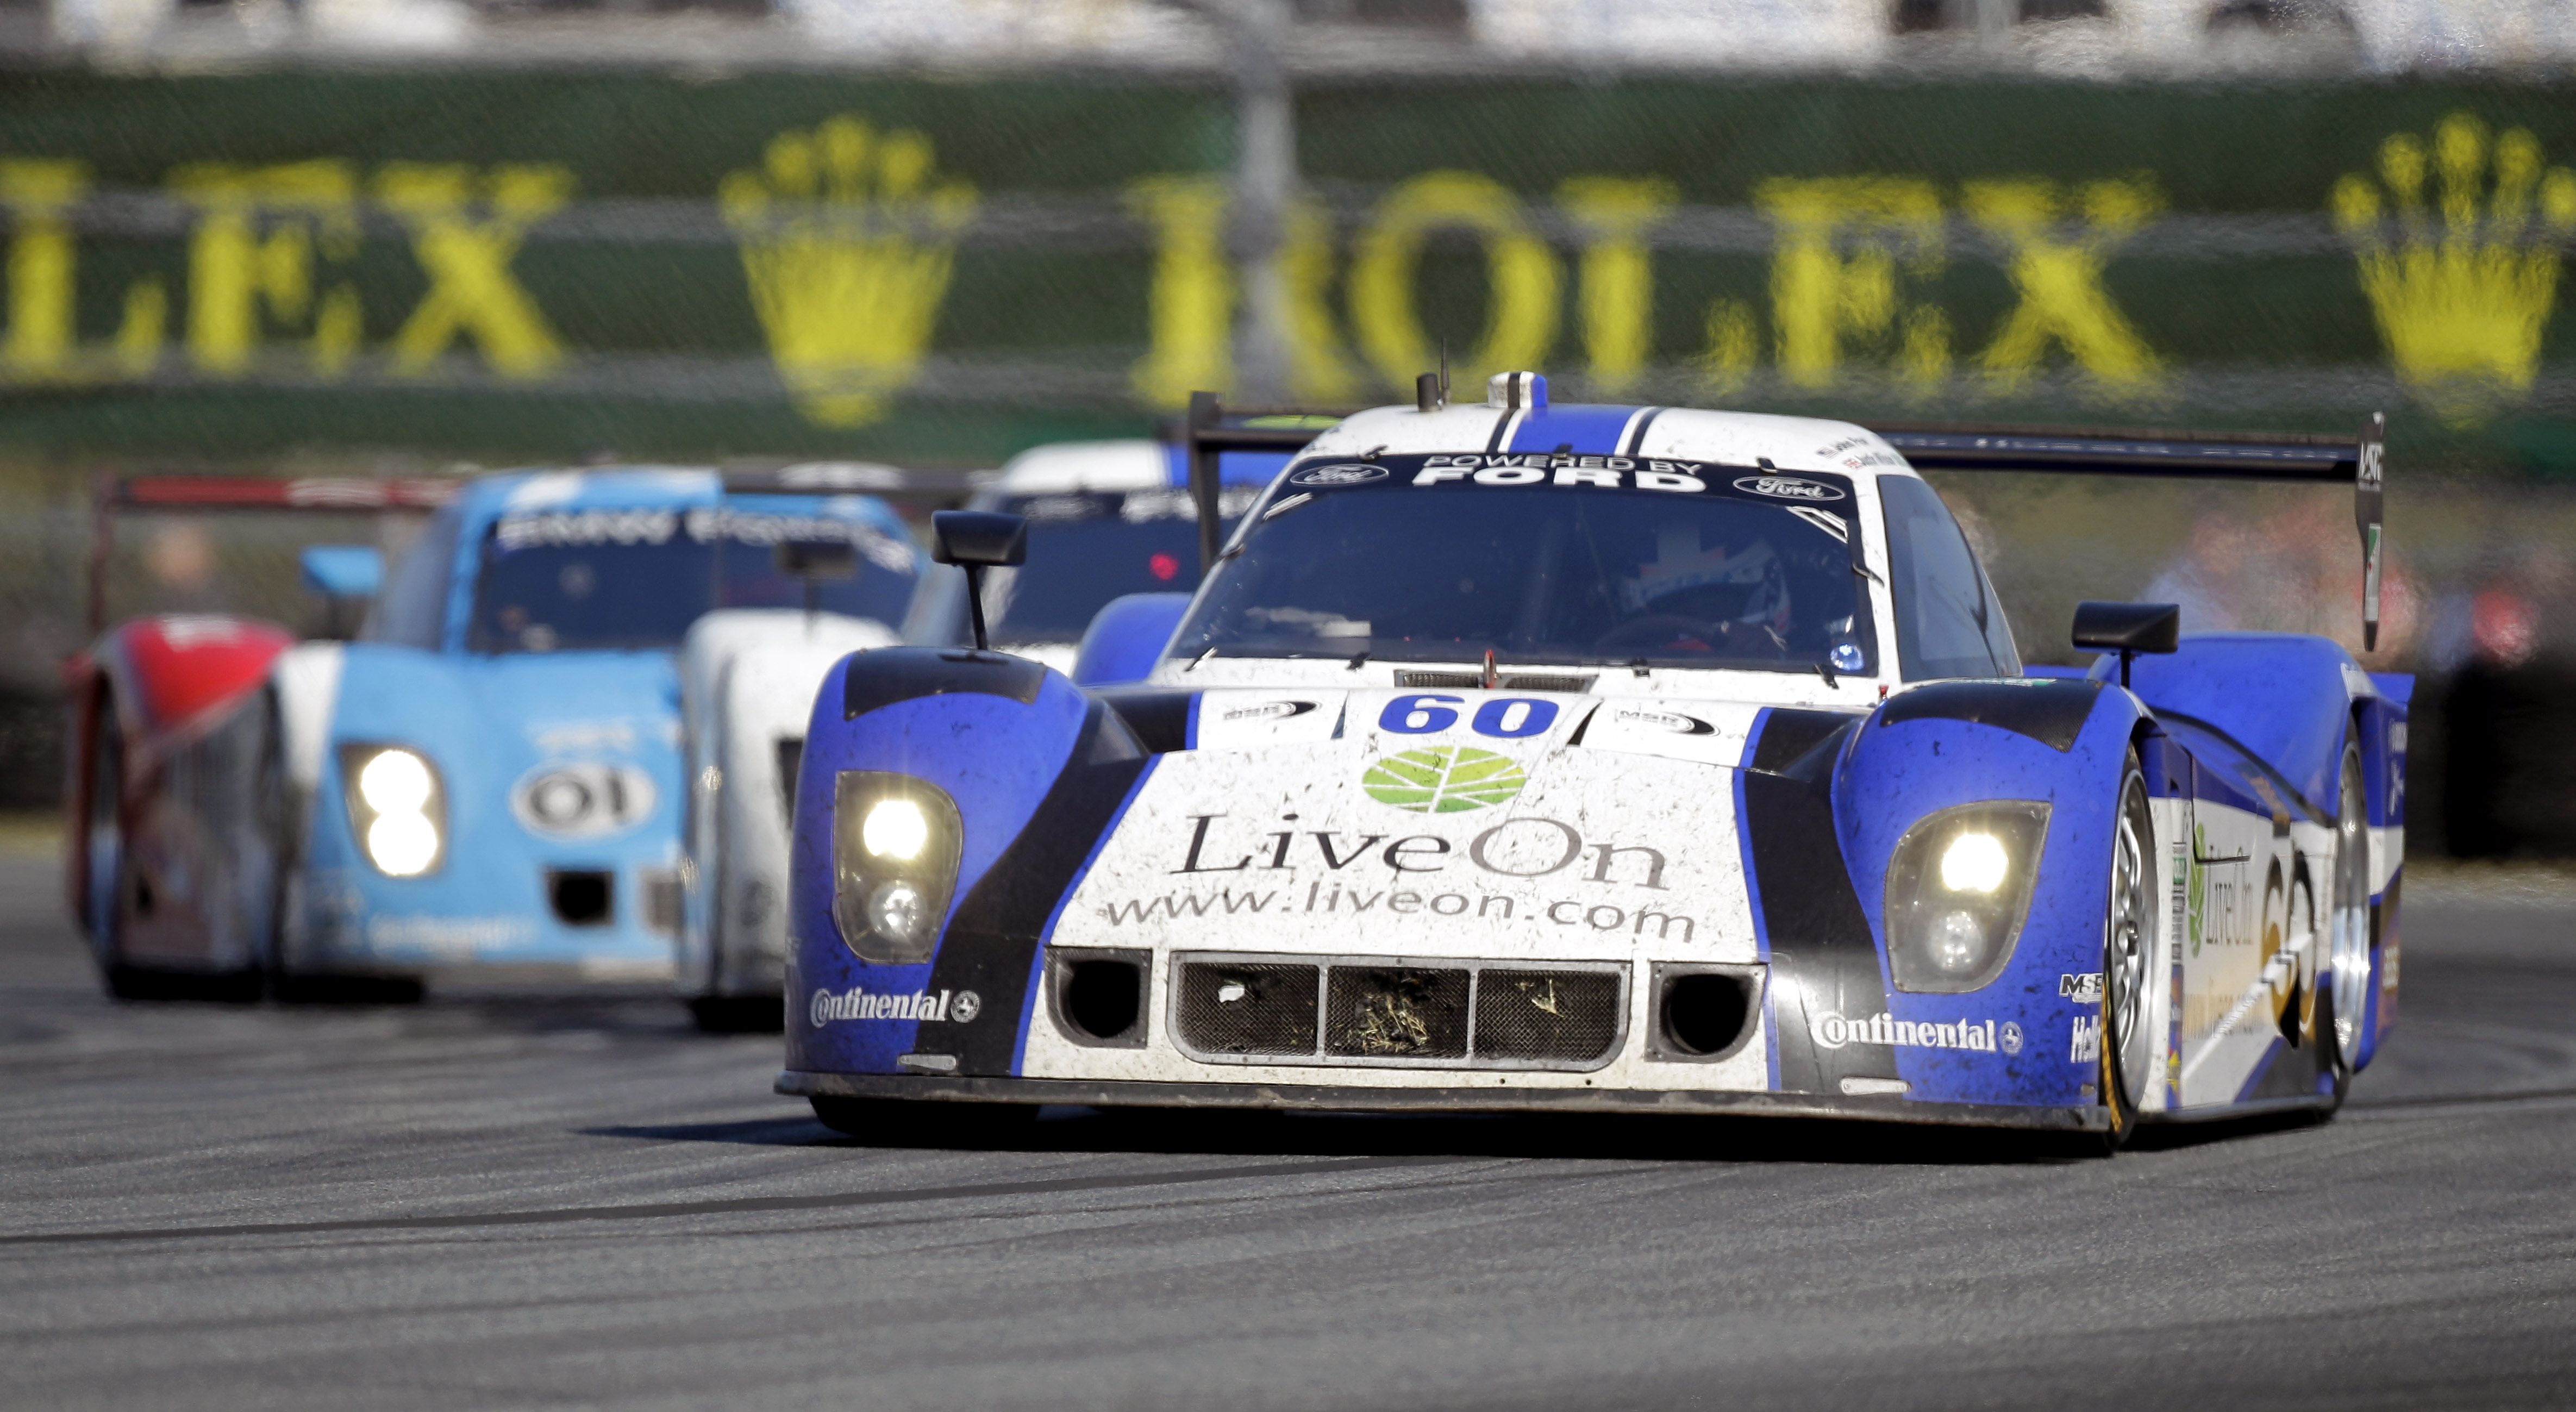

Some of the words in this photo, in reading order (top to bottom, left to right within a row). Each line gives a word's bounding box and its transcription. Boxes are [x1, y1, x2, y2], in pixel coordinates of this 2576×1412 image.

[1124, 168, 2166, 407] ROLEX
[1304, 465, 1373, 483] Ford
[1412, 466, 1706, 493] FORD
[1424, 454, 1635, 471] POWERED
[1649, 460, 1703, 475] BY
[1755, 476, 1825, 498] Ford
[1378, 694, 1560, 739] 60
[1105, 881, 1695, 944] www.liveon.com
[809, 986, 952, 1028] Continental
[1810, 1010, 1998, 1053] Continental
